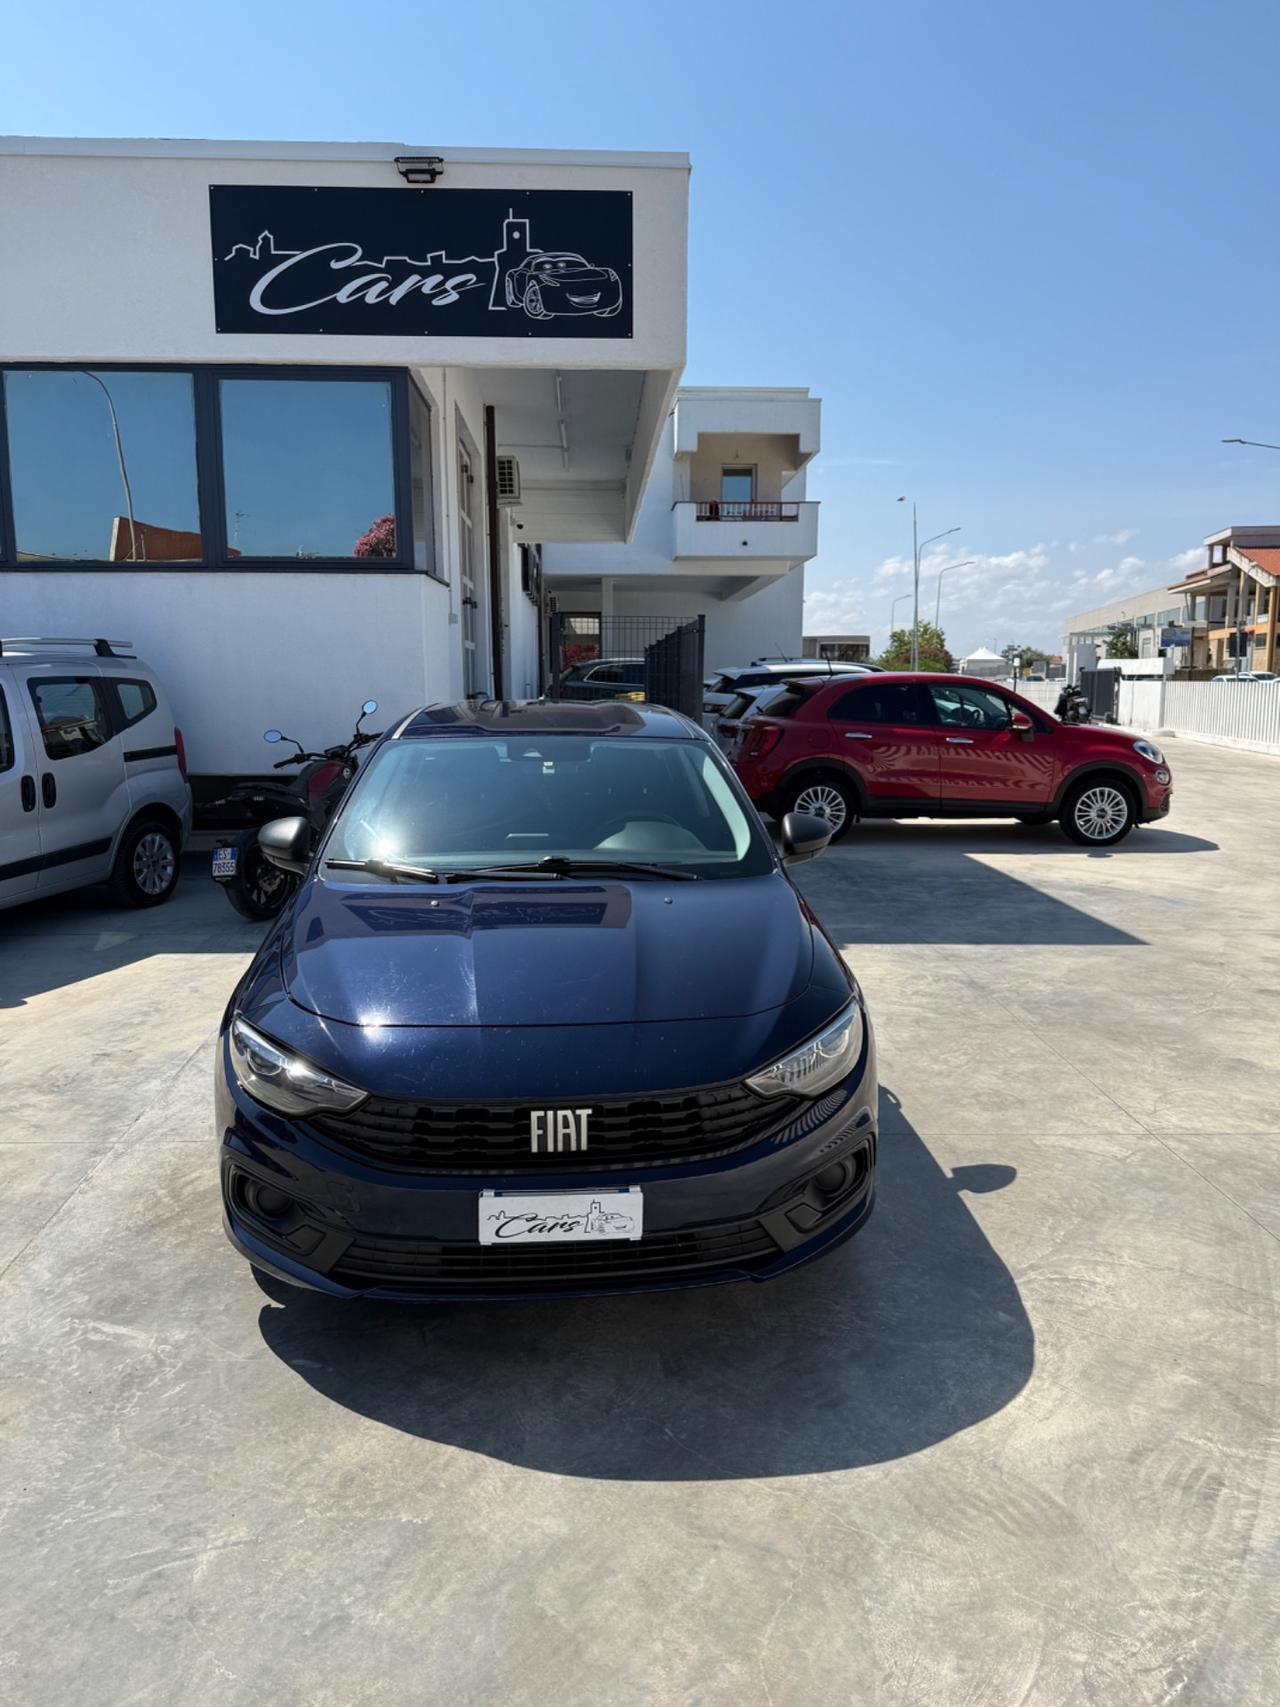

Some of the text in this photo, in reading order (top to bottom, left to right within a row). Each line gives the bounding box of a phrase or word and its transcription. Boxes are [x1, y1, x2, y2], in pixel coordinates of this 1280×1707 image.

[249, 243, 486, 315] Cars
[530, 1109, 592, 1152] FIAT
[495, 1213, 582, 1238] Cars
